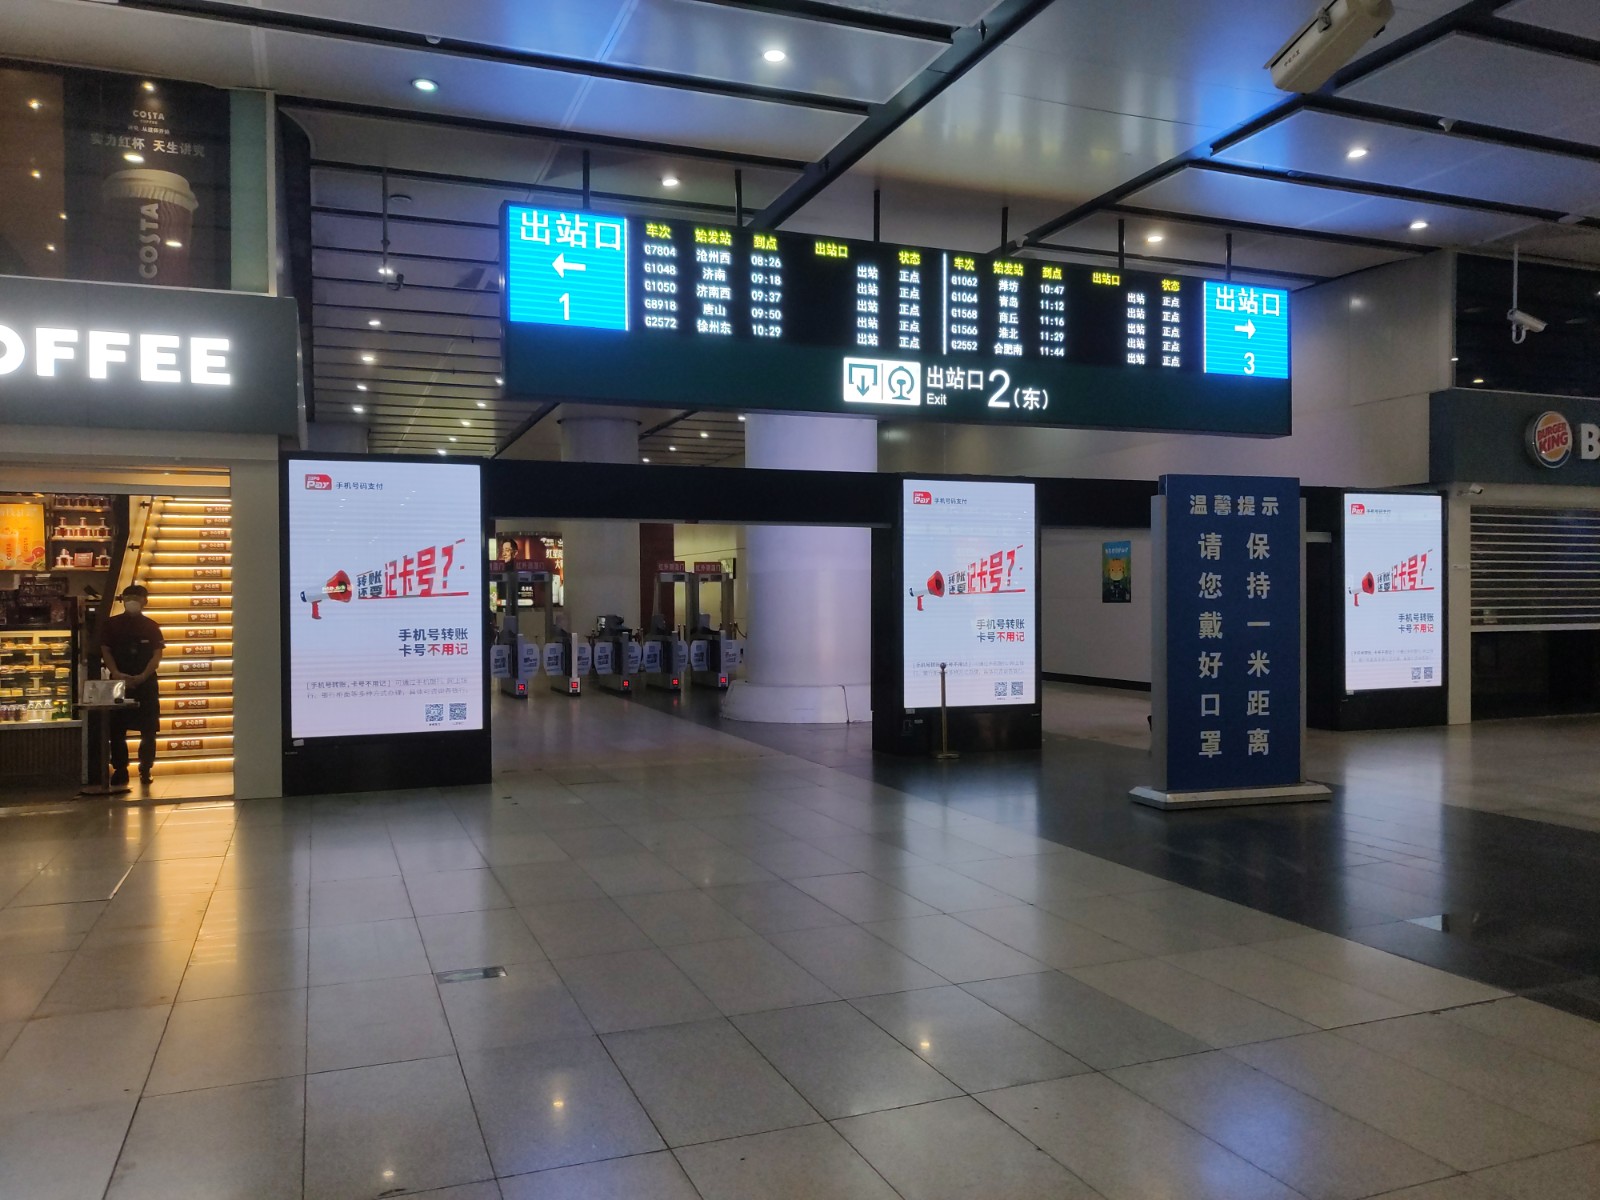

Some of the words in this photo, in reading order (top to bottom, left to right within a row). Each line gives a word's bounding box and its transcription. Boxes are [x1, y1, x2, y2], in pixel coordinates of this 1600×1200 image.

[133, 110, 165, 120] COSTA
[139, 203, 160, 278] COSTA
[520, 211, 621, 251] 出站口
[646, 224, 672, 239] 车次
[695, 229, 732, 246] 始发站
[754, 235, 778, 251] 到点
[815, 242, 849, 258] 出站口
[899, 251, 921, 266] 状态
[644, 244, 677, 258] G7804
[696, 250, 731, 265] 沧州西
[751, 256, 781, 268] 08:26
[857, 266, 879, 280] 出站
[899, 270, 920, 284] 正点
[954, 257, 975, 271] 车次
[993, 261, 1023, 277] 始发站
[1042, 267, 1062, 280] 到点
[1092, 272, 1120, 286] 出站口
[1162, 279, 1181, 292] 状态
[645, 263, 677, 276] G1048
[703, 268, 726, 282] 济南
[751, 273, 781, 286] 09:18
[857, 282, 879, 297] 出站
[899, 287, 920, 300] 正点
[951, 276, 978, 288] G1062
[1040, 285, 1065, 296] 10:47
[1127, 293, 1145, 305] 出站
[1162, 296, 1180, 308] 正点
[559, 293, 570, 321] 1
[645, 281, 677, 294] G1050
[696, 284, 731, 299] 济南西
[751, 290, 781, 303] 09:37
[857, 299, 879, 313] 出站
[899, 303, 920, 317] 正点
[951, 292, 978, 304] G1064
[999, 296, 1019, 308] 青岛
[1040, 300, 1065, 312] 11:12
[1127, 308, 1145, 320] 出站
[1162, 312, 1180, 323] 正点
[1215, 286, 1280, 317] 出站口
[645, 299, 677, 312] G8918
[703, 303, 726, 317] 唐山
[751, 308, 781, 320] 09:50
[857, 316, 879, 330] 出站
[899, 320, 920, 333] 正点
[951, 309, 978, 320] G1568
[999, 313, 1019, 325] 商丘
[1040, 316, 1065, 327] 11:16
[1127, 324, 1145, 335] 出站
[1162, 327, 1180, 338] 正点
[645, 316, 677, 329] G2572
[697, 320, 732, 335] 徐州东
[752, 325, 781, 337] 10:29
[857, 333, 879, 346] 出站
[899, 336, 920, 349] 正点
[951, 324, 978, 336] G1566
[1040, 331, 1065, 343] 11:29
[1127, 338, 1145, 350] 出站
[1162, 342, 1180, 353] 正点
[951, 340, 978, 352] G2552
[994, 343, 1023, 356] 合肥南
[1040, 347, 1065, 358] 11:44
[1127, 353, 1145, 365] 出站
[1162, 356, 1180, 367] 正点
[1243, 352, 1255, 375] 3
[927, 366, 984, 391] 出站口
[927, 393, 947, 406] Exit
[1537, 421, 1567, 441] BURGER
[1539, 431, 1569, 454] KING
[1580, 424, 1600, 460] B
[306, 481, 330, 489] Pay
[336, 482, 383, 490] 手机号码支付
[1189, 494, 1279, 516] 温馨提示
[357, 571, 382, 588] 转账
[976, 619, 1025, 630] 手机号转账
[1398, 613, 1434, 622] 手机号转账
[1398, 624, 1434, 633] 卡号不用记
[399, 628, 468, 641] 手机号转账
[977, 632, 1025, 642] 卡号不用记
[1198, 533, 1223, 758] 请您戴好口罩
[1246, 533, 1271, 756] 保持一米距离
[399, 643, 468, 657] 卡号不用记
